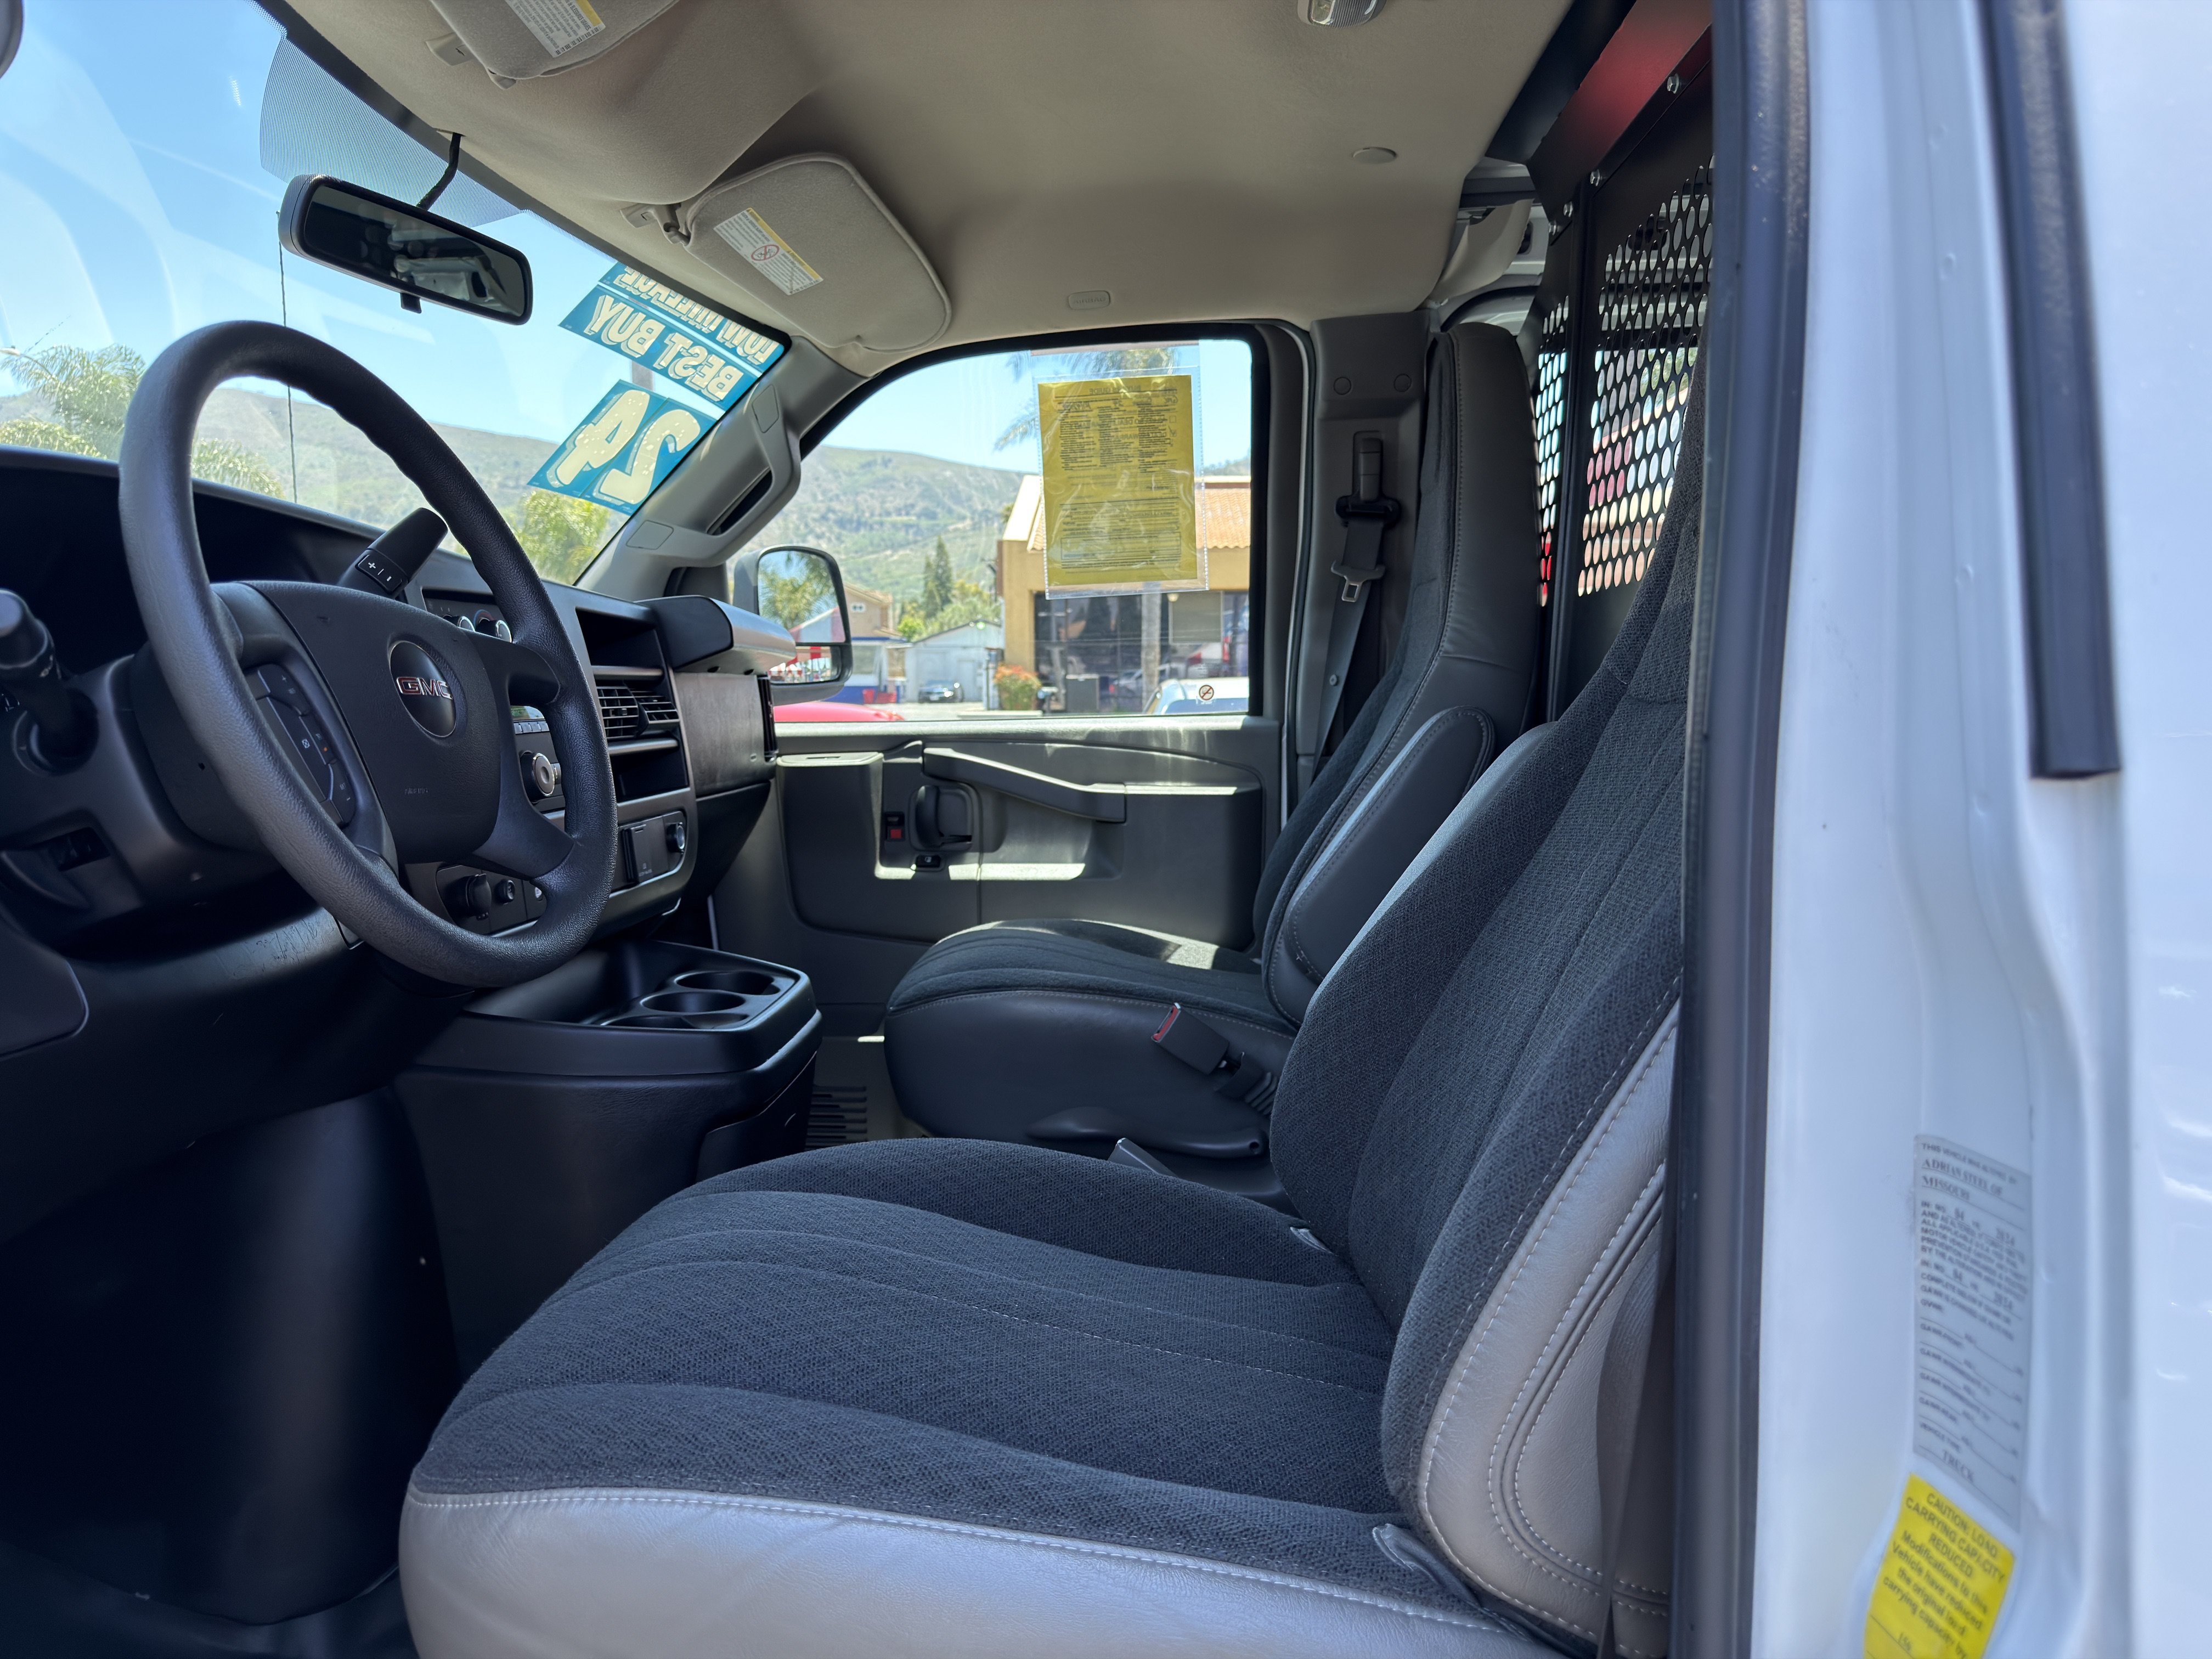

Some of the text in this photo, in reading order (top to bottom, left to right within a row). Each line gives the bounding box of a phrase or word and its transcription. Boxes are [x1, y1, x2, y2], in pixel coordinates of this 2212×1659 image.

[397, 676, 453, 700] GMC
[1922, 1143, 1941, 1153] THIS
[1922, 1159, 1961, 1177] ADRIAN
[1963, 1170, 1988, 1191] STEEL
[1922, 1176, 1970, 1200] MISSOURI
[1905, 1497, 1957, 1542] CARRYING
[1893, 1542, 1924, 1575] Vehicle
[1925, 1573, 1945, 1595] have
[1903, 1530, 1959, 1588] Modifications
[1929, 1533, 1973, 1578] REDUCED
[1883, 1576, 1918, 1615] carrying
[1897, 1566, 1911, 1585] the
[1913, 1581, 1945, 1616] original
